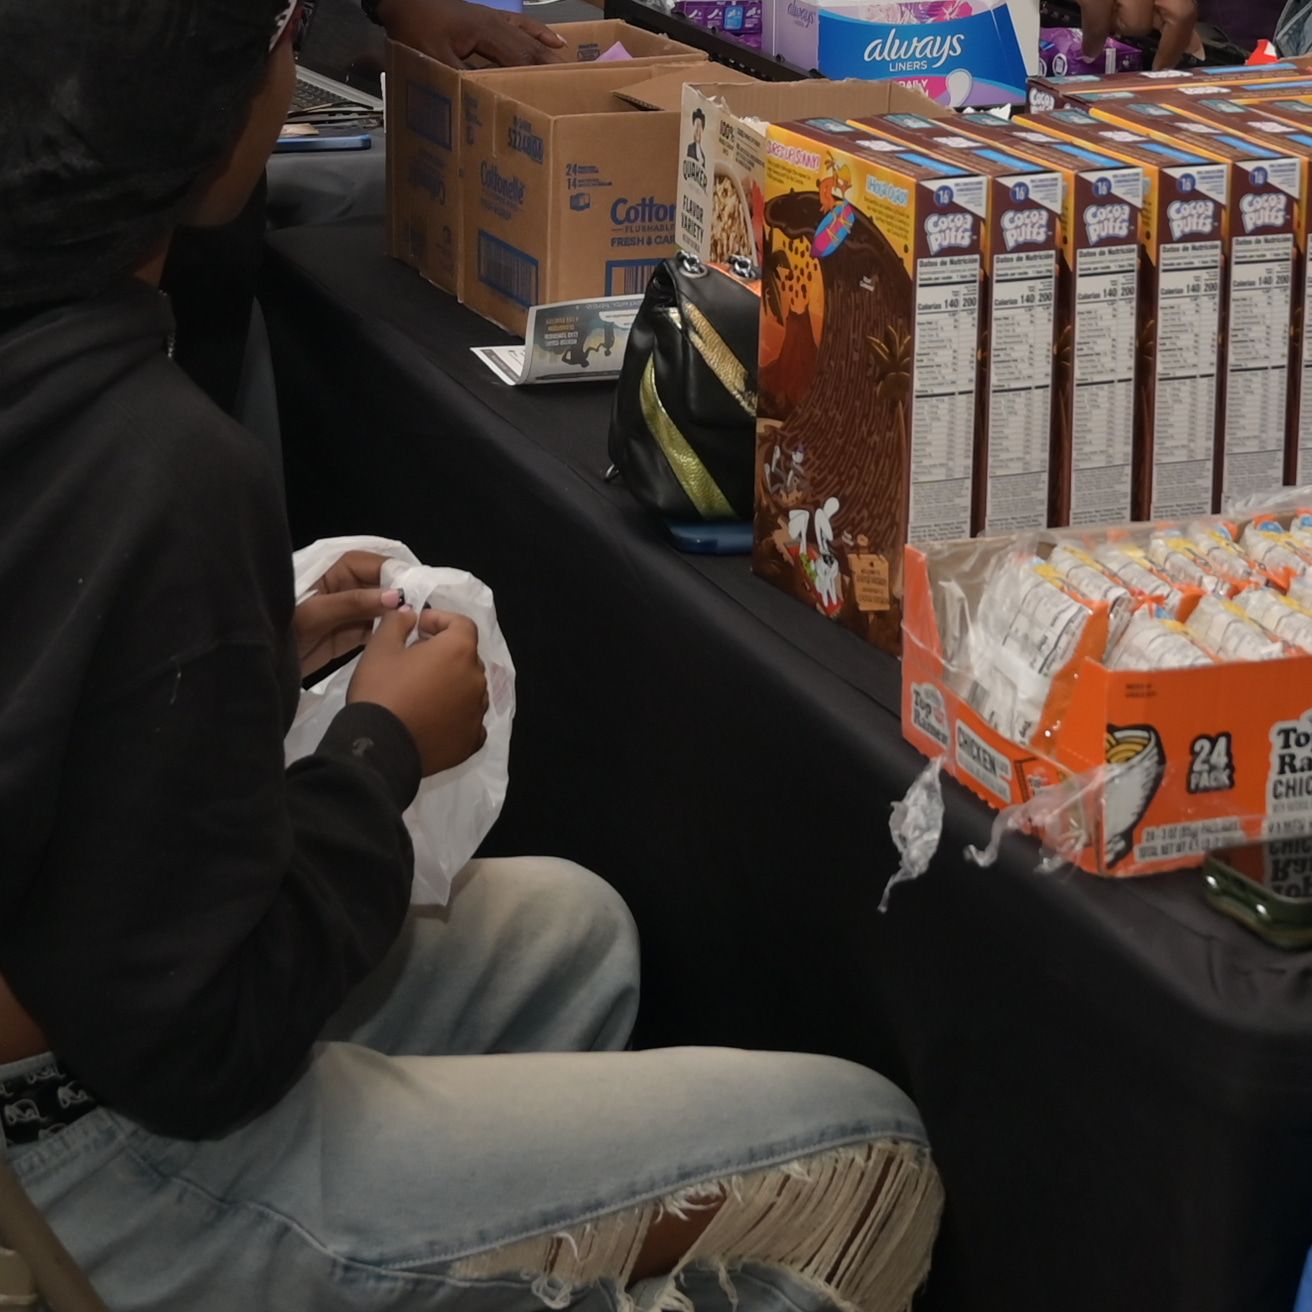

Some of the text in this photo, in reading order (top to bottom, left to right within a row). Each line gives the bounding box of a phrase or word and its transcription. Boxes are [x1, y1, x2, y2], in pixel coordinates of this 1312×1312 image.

[864, 28, 965, 68] always
[889, 60, 927, 72] LINERS
[566, 164, 577, 176] 24
[567, 178, 577, 190] 14
[683, 159, 707, 191] QUAKER
[610, 197, 676, 225] Cotton
[683, 195, 703, 224] FLAVOR
[611, 236, 644, 247] FRESH
[681, 212, 704, 243] VARIETY
[913, 689, 932, 718] Top
[959, 725, 997, 774] CHICKEN
[1192, 736, 1229, 772] 24
[1190, 769, 1231, 790] PACK
